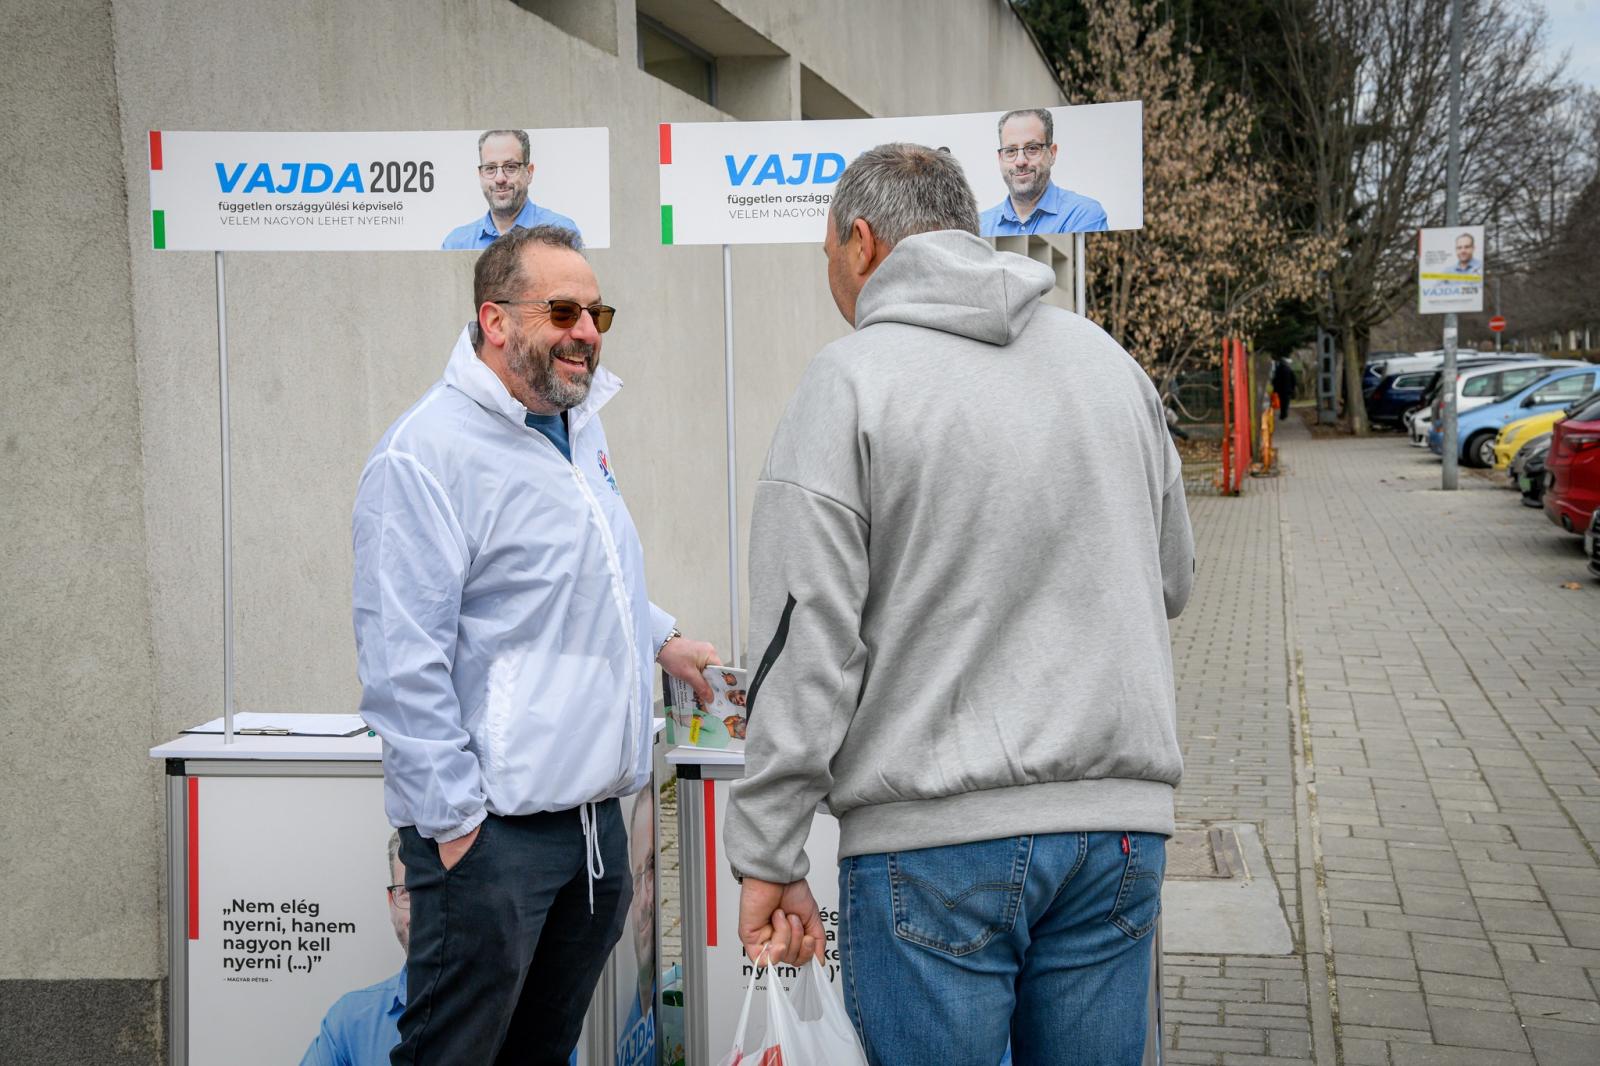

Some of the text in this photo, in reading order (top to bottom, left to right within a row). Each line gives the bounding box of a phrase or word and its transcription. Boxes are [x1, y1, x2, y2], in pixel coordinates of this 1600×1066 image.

[215, 161, 434, 194] VAJDA 2026
[724, 152, 846, 187] VAJD
[218, 201, 404, 213] független országgyűlési képviselő
[727, 193, 834, 206] független országg
[220, 216, 404, 226] VELEM NAGYON LEHET NYERNI!
[729, 208, 825, 219] VELEM NAGYON
[280, 899, 320, 917] elég
[223, 917, 356, 935] nyerni, hanem
[223, 937, 330, 953] nagyon kell
[223, 954, 281, 972] nyerni
